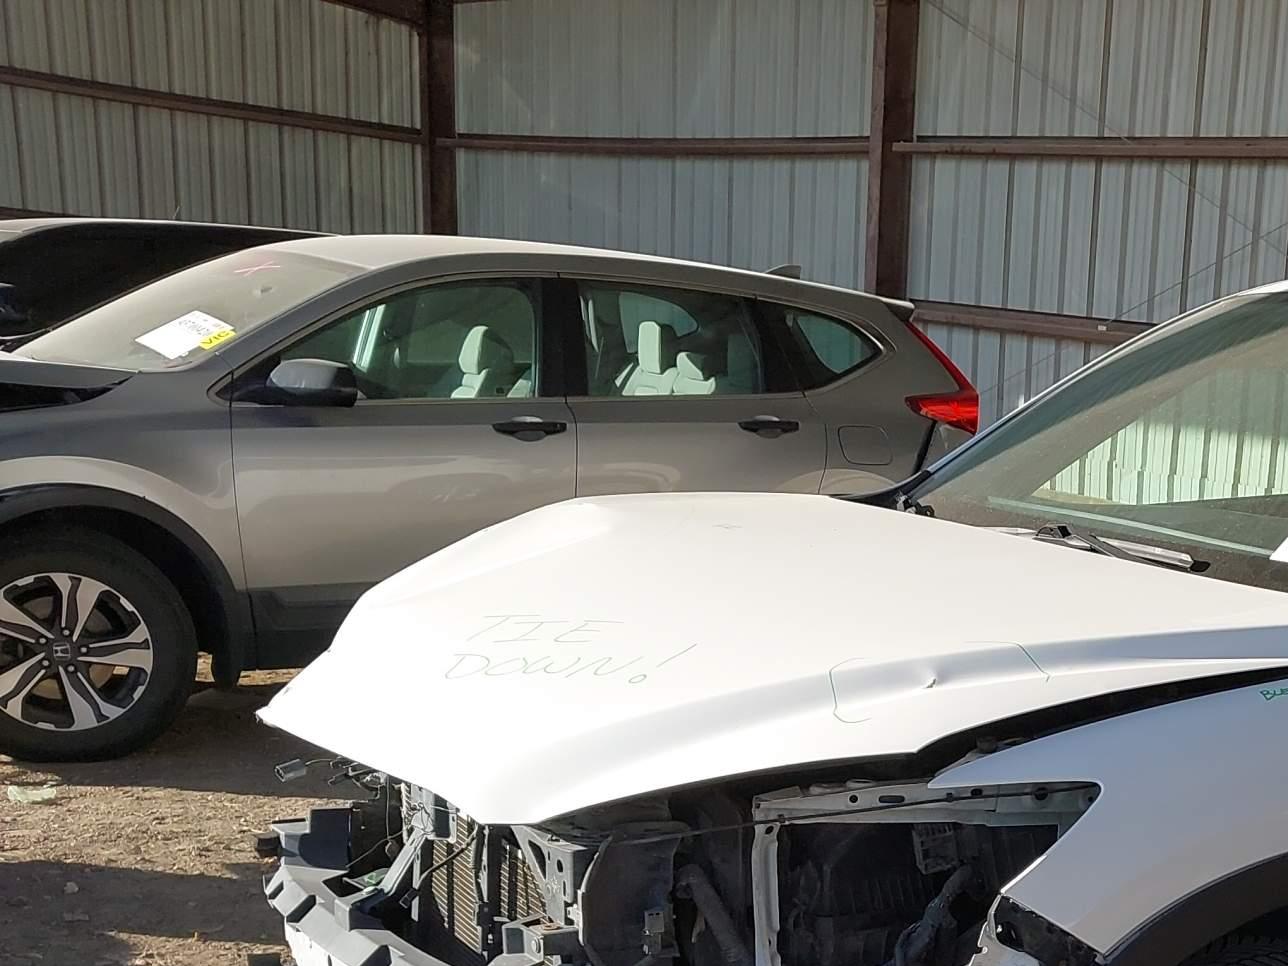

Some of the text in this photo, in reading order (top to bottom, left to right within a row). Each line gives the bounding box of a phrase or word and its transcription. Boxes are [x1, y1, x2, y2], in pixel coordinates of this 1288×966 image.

[200, 330, 230, 345] VIC
[466, 614, 626, 644] TIE
[444, 643, 698, 685] DOWN!
